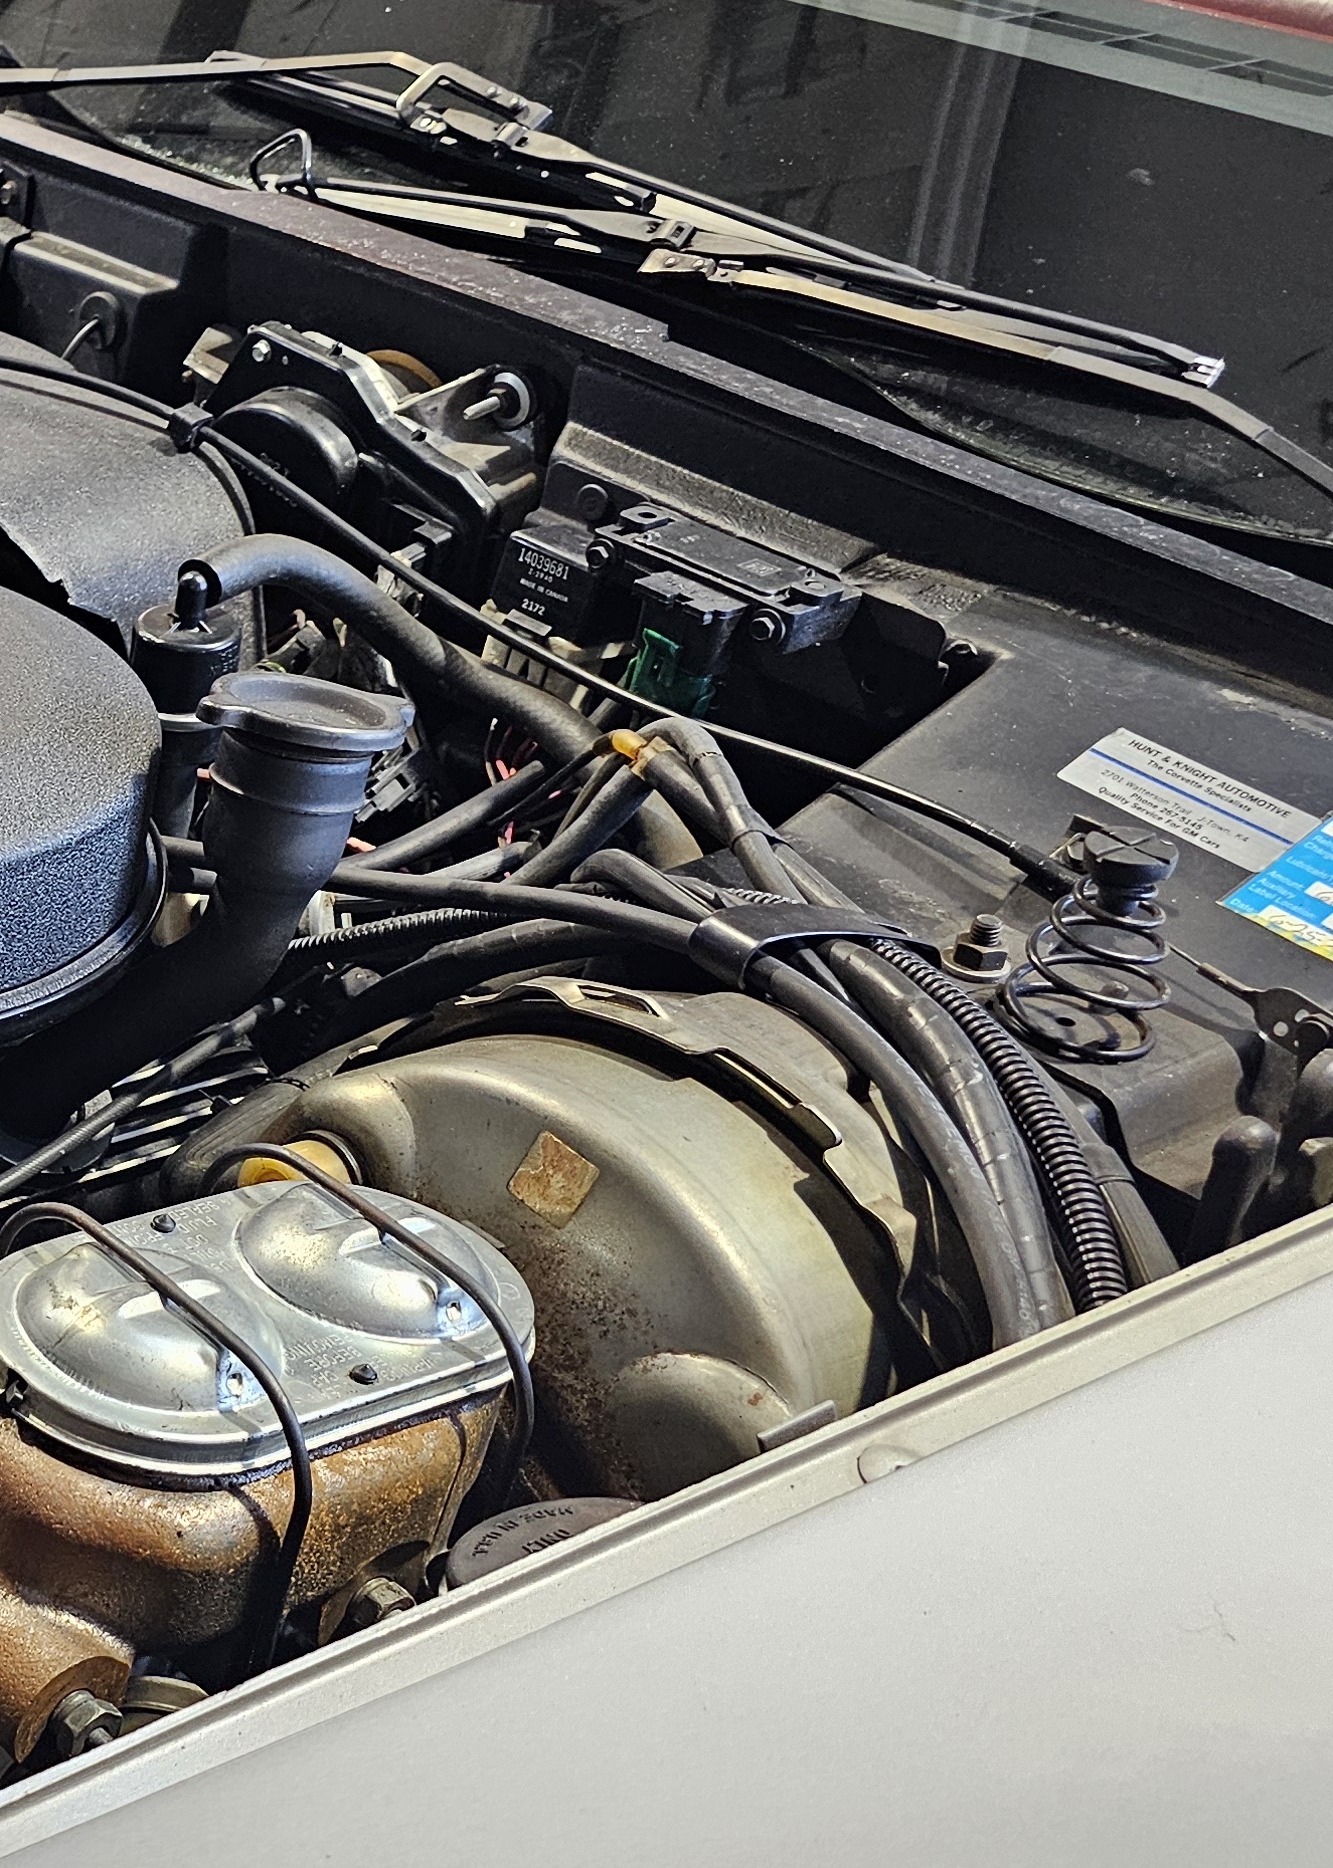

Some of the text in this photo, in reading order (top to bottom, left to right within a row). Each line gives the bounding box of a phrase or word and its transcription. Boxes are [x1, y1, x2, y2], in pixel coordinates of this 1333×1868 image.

[518, 547, 569, 580] 14039681
[521, 598, 545, 616] 2172
[1101, 769, 1124, 783] 2701
[1128, 739, 1292, 818] HUNT & KNIGHT AUTOMOTIVE
[1147, 759, 1252, 812] The Corvette Specialists
[1129, 792, 1159, 810] Phone
[1098, 786, 1221, 849] Quality Service For GM Cars
[1248, 883, 1276, 900] Label
